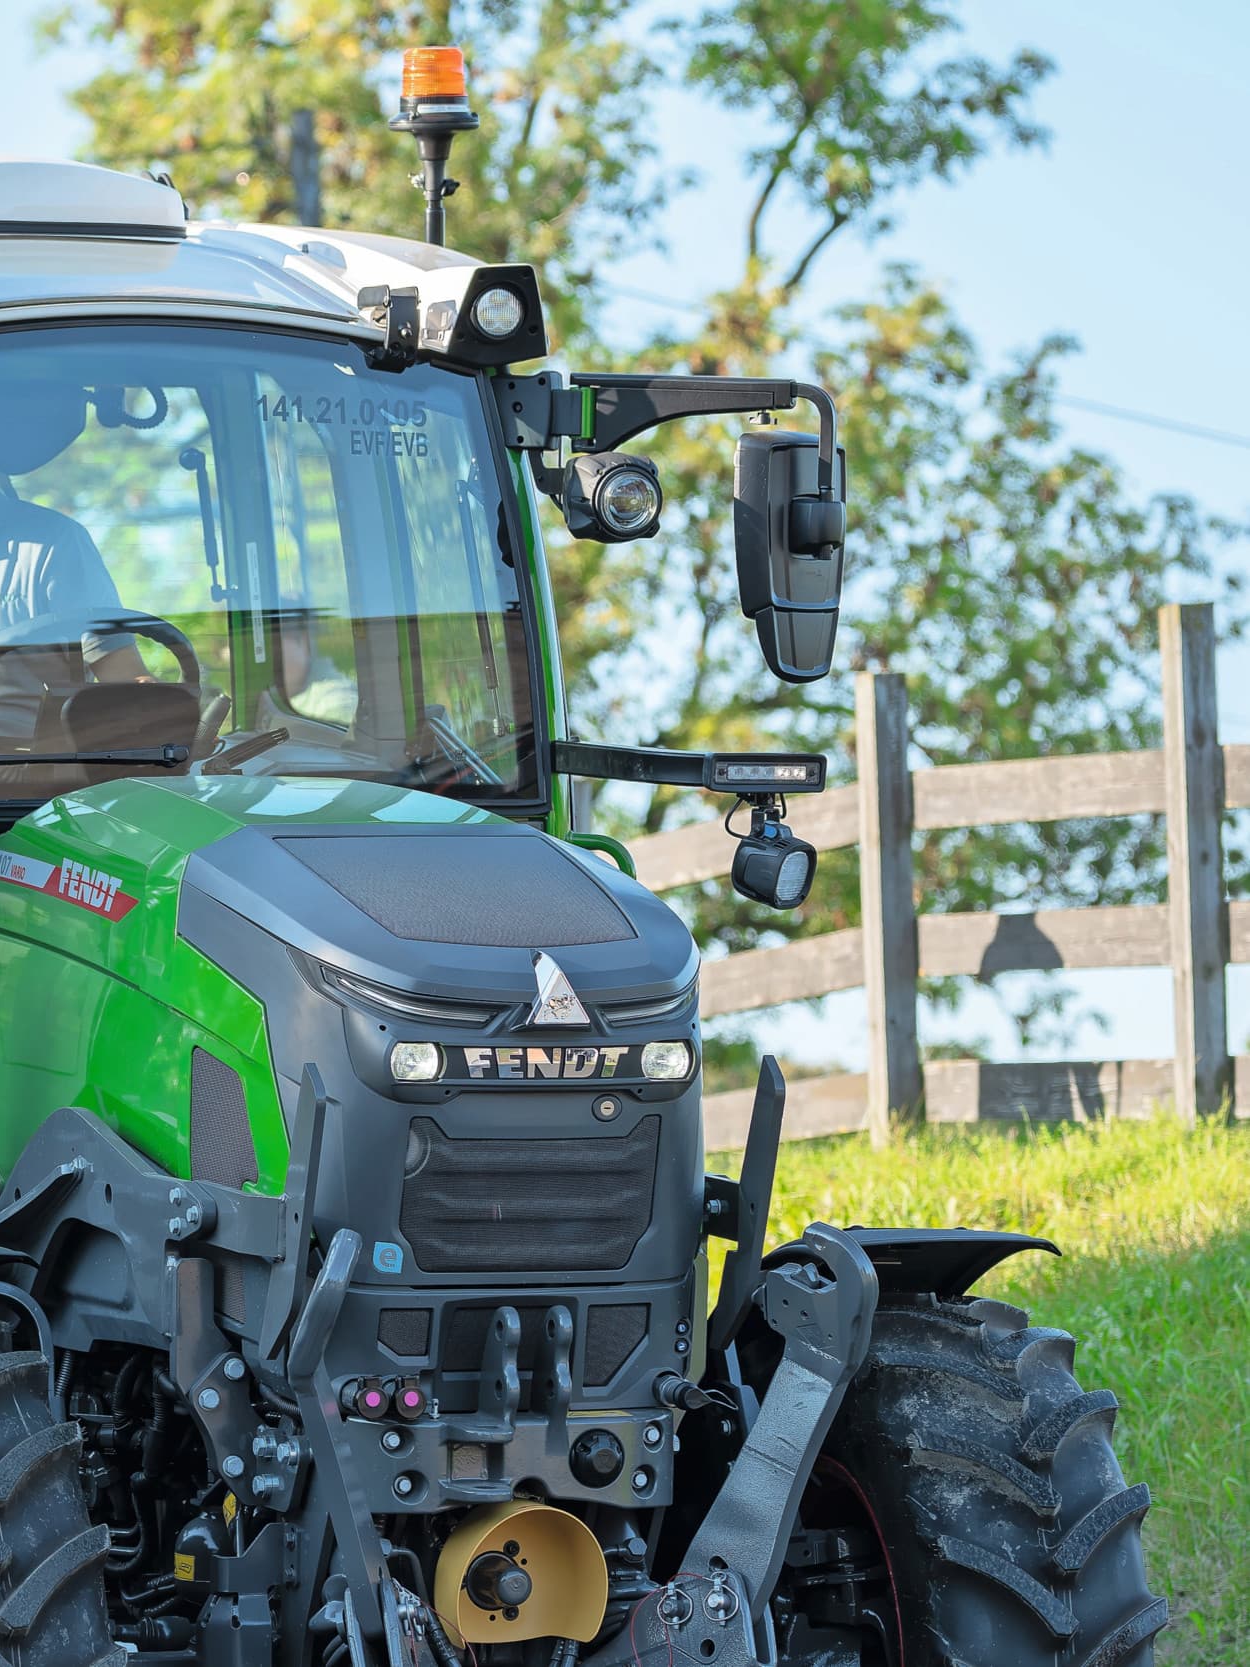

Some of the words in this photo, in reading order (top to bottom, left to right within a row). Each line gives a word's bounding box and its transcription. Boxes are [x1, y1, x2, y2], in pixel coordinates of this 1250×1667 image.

[256, 394, 427, 427] 141.21.0105
[351, 429, 428, 457] EVF/EVB
[58, 857, 123, 912] FENDT
[463, 1046, 629, 1079] FENDT
